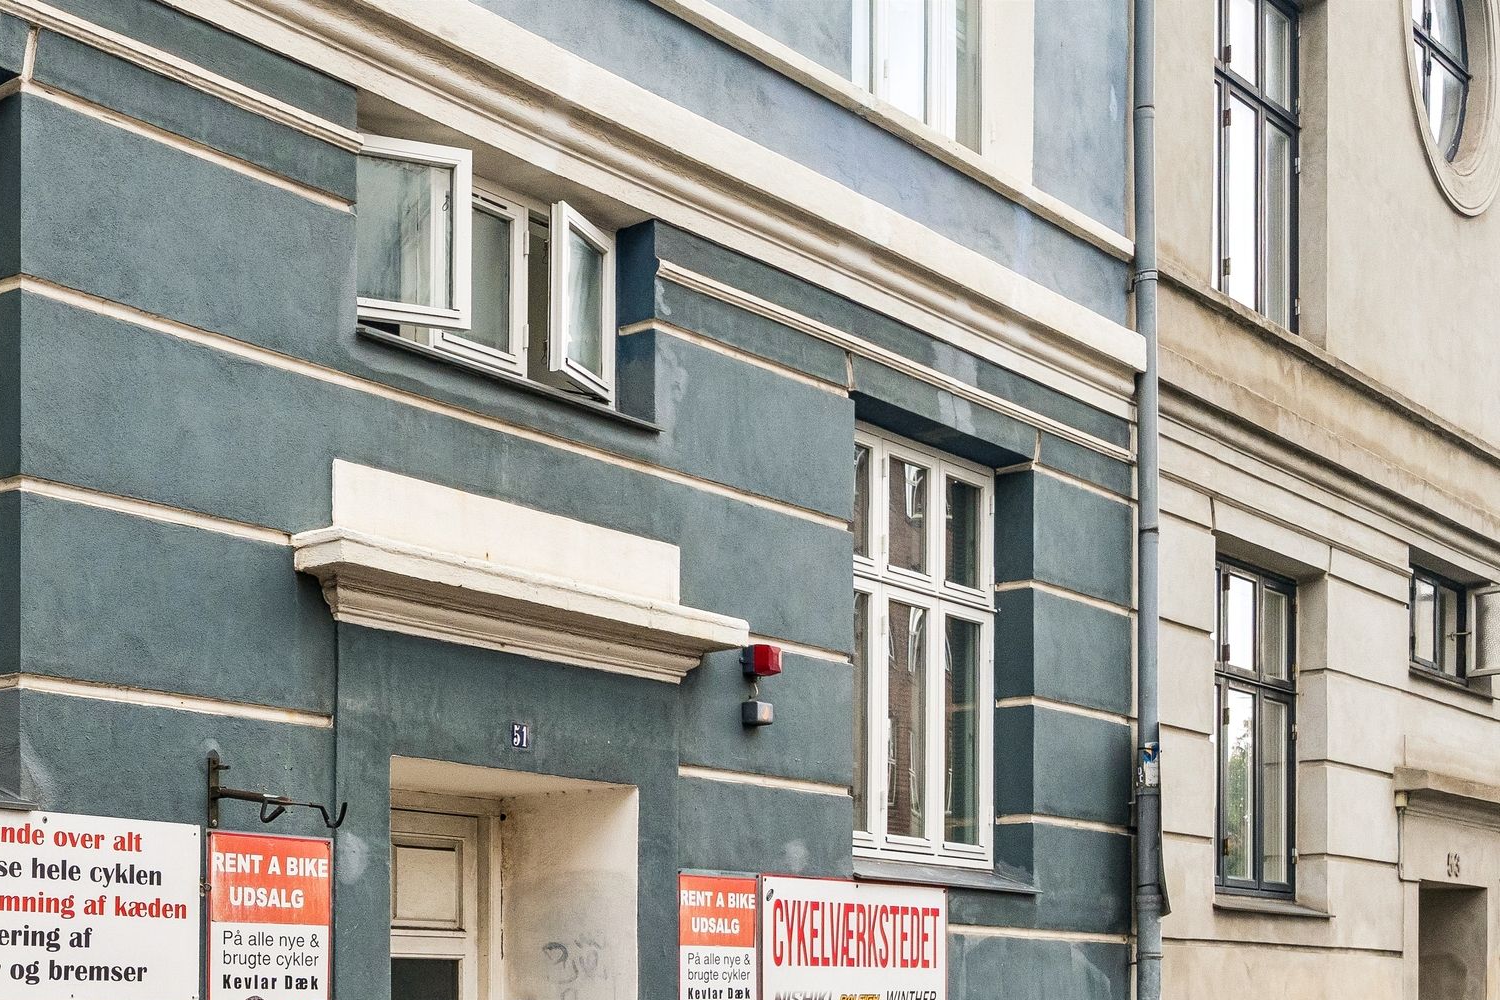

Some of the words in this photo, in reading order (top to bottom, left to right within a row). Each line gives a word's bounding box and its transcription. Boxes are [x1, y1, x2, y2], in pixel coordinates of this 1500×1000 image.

[513, 724, 527, 747] 51
[53, 830, 105, 849] over
[113, 832, 142, 852] alt
[32, 858, 81, 881] hele
[90, 863, 162, 887] cyklen
[212, 852, 263, 873] RENT
[268, 857, 281, 875] A
[286, 857, 328, 878] BIKE
[83, 895, 106, 915] af
[115, 896, 187, 919] kæden
[229, 886, 304, 908] UDSALG
[680, 889, 713, 907] RENT
[715, 892, 724, 908] A
[728, 892, 755, 909] BIKE
[691, 916, 740, 934] UDSALG
[773, 898, 940, 969] CYKELVÆRKSTEDET
[69, 927, 92, 948] af
[223, 930, 243, 946] På
[248, 932, 274, 946] alle
[279, 934, 305, 950] nye
[310, 934, 320, 948] &
[223, 950, 271, 969] brugte
[276, 952, 319, 969] cykler
[687, 952, 700, 965] På
[704, 953, 720, 965] alle
[724, 955, 740, 968] nye
[744, 954, 750, 965] &
[10, 961, 40, 985] og
[49, 959, 147, 982] bremser
[222, 974, 277, 989] Kevlar
[285, 975, 319, 990] Dæk
[687, 968, 718, 983] brugte
[722, 969, 750, 983] cykler
[687, 987, 722, 1000] Kevlar
[728, 987, 750, 1000] Dæk
